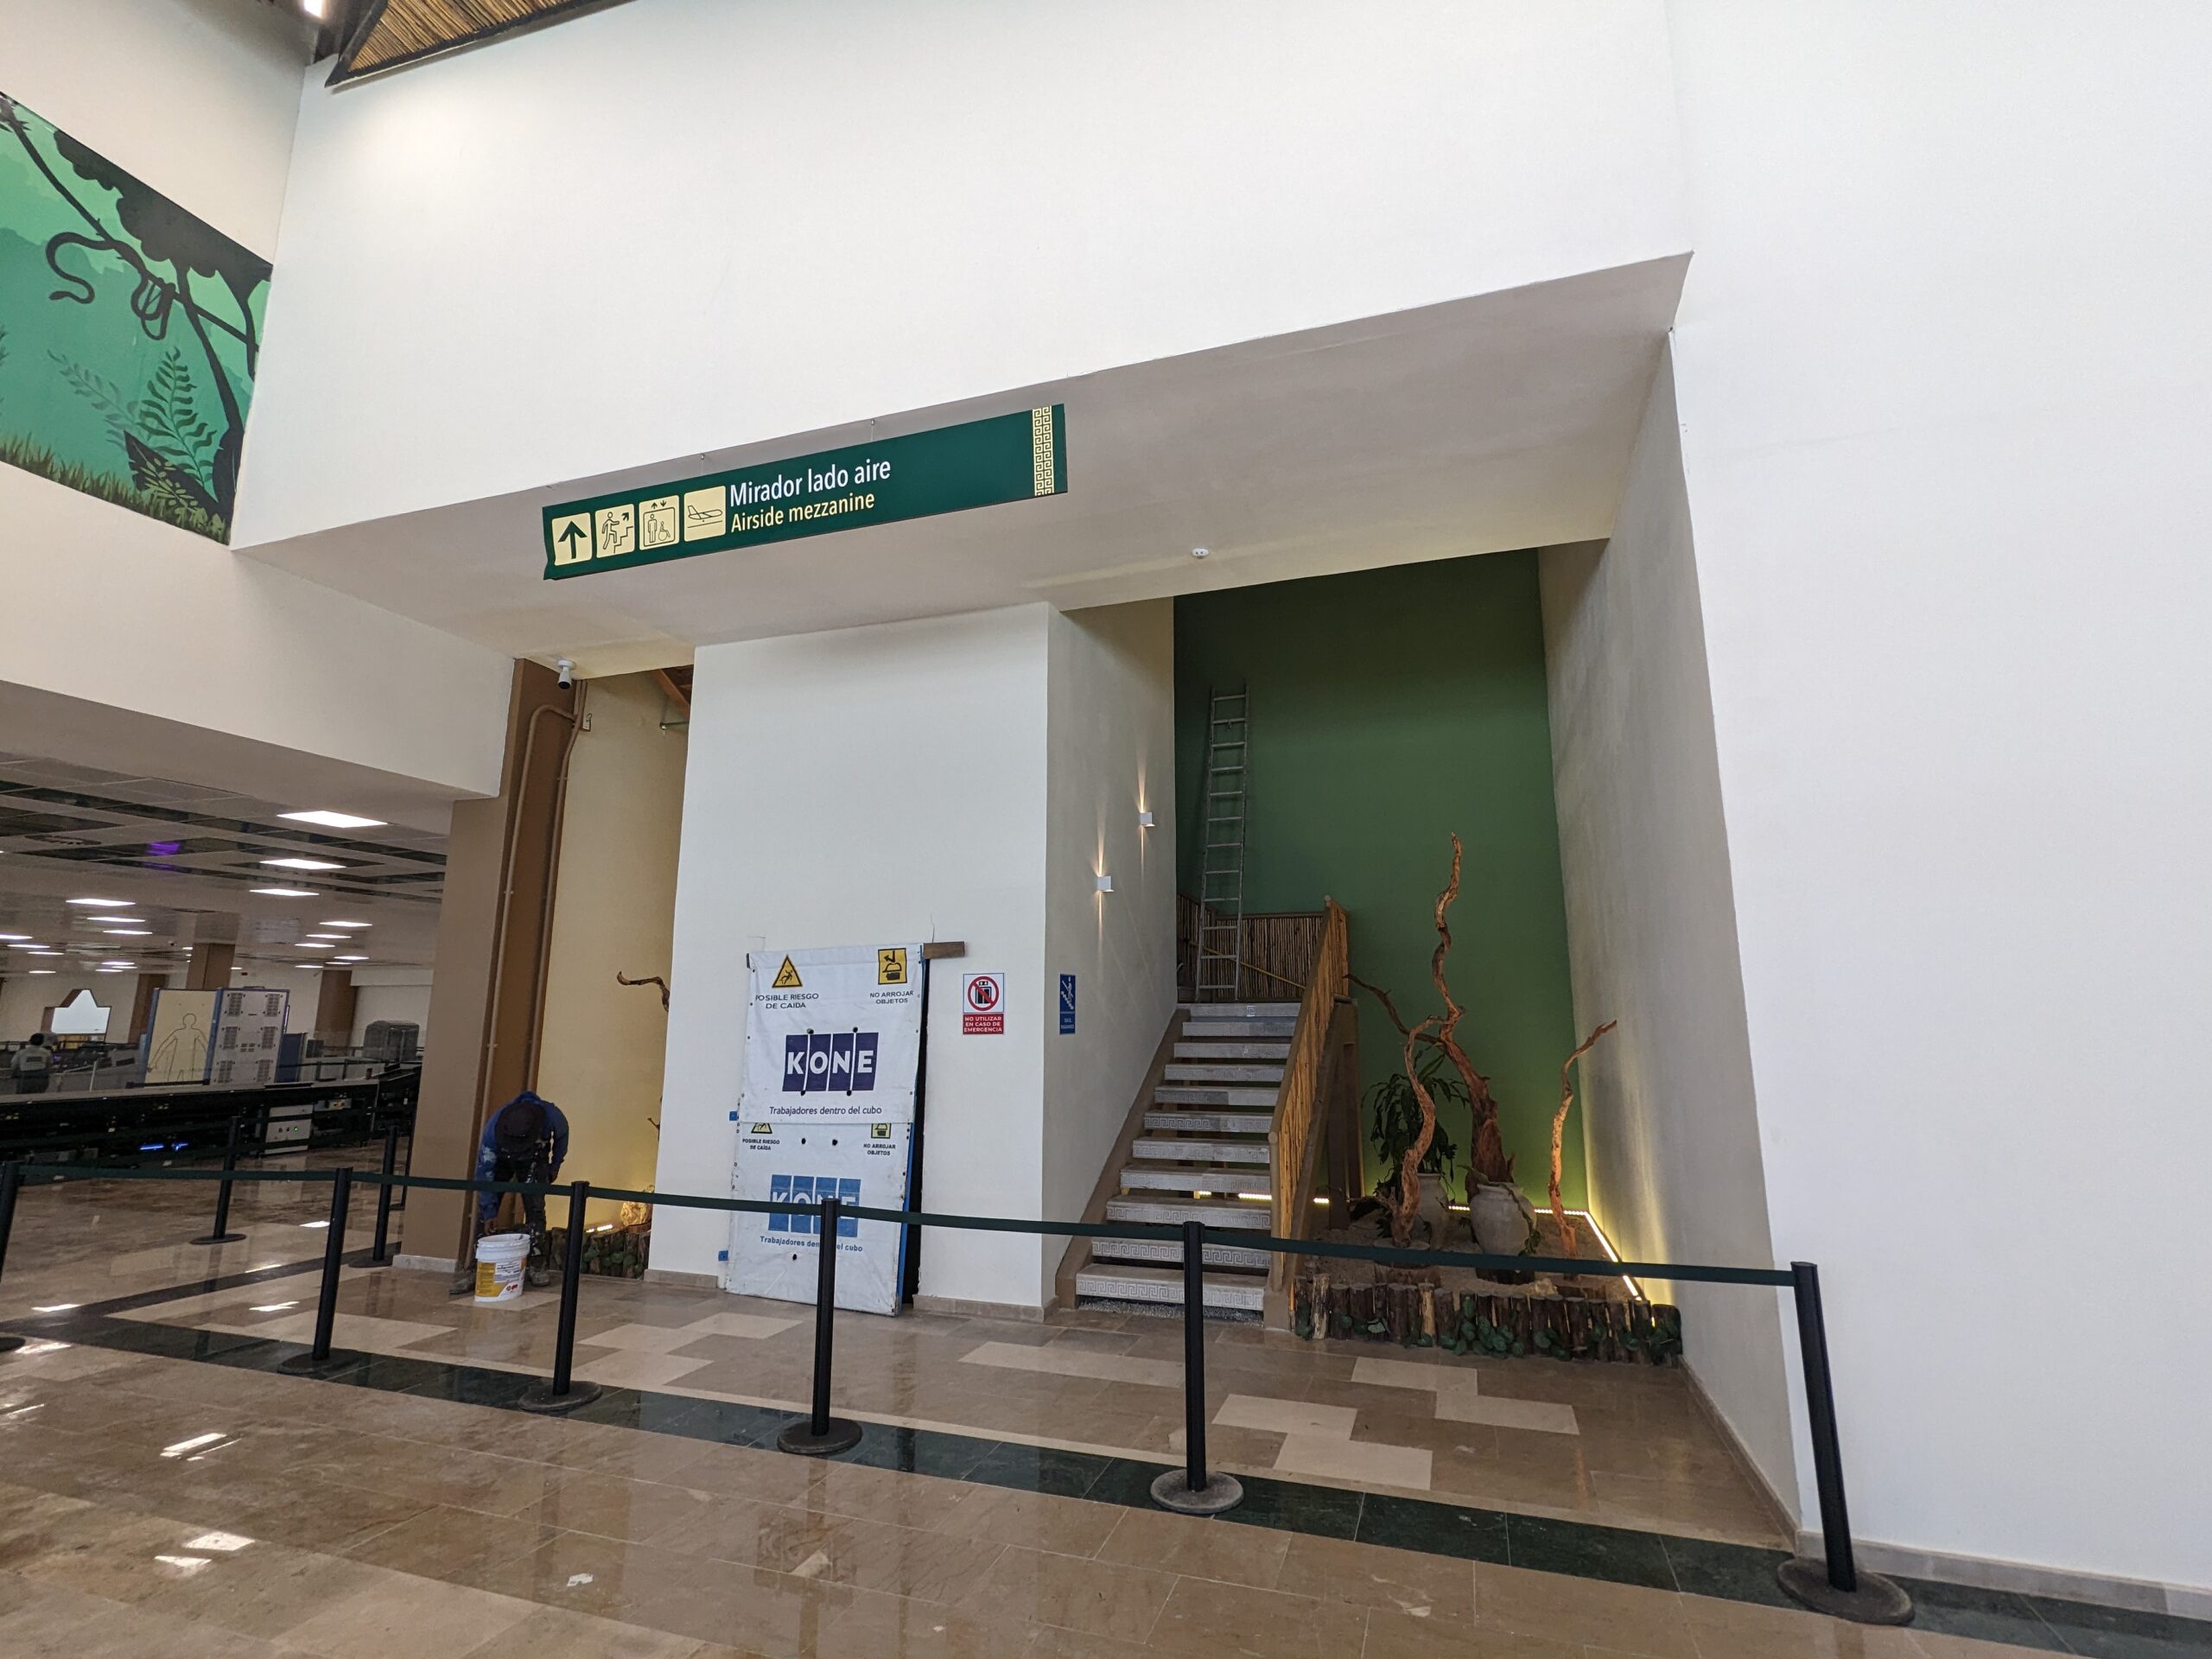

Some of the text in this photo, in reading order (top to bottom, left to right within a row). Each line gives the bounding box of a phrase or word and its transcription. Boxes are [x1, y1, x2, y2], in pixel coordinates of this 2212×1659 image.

[730, 458, 891, 506] Mirador lado aire
[731, 492, 875, 533] Airside mezzanine
[787, 1050, 874, 1075] KONE
[769, 1106, 882, 1116] Trabajadores dentro del cubo
[760, 1236, 804, 1247] Trabajadores
